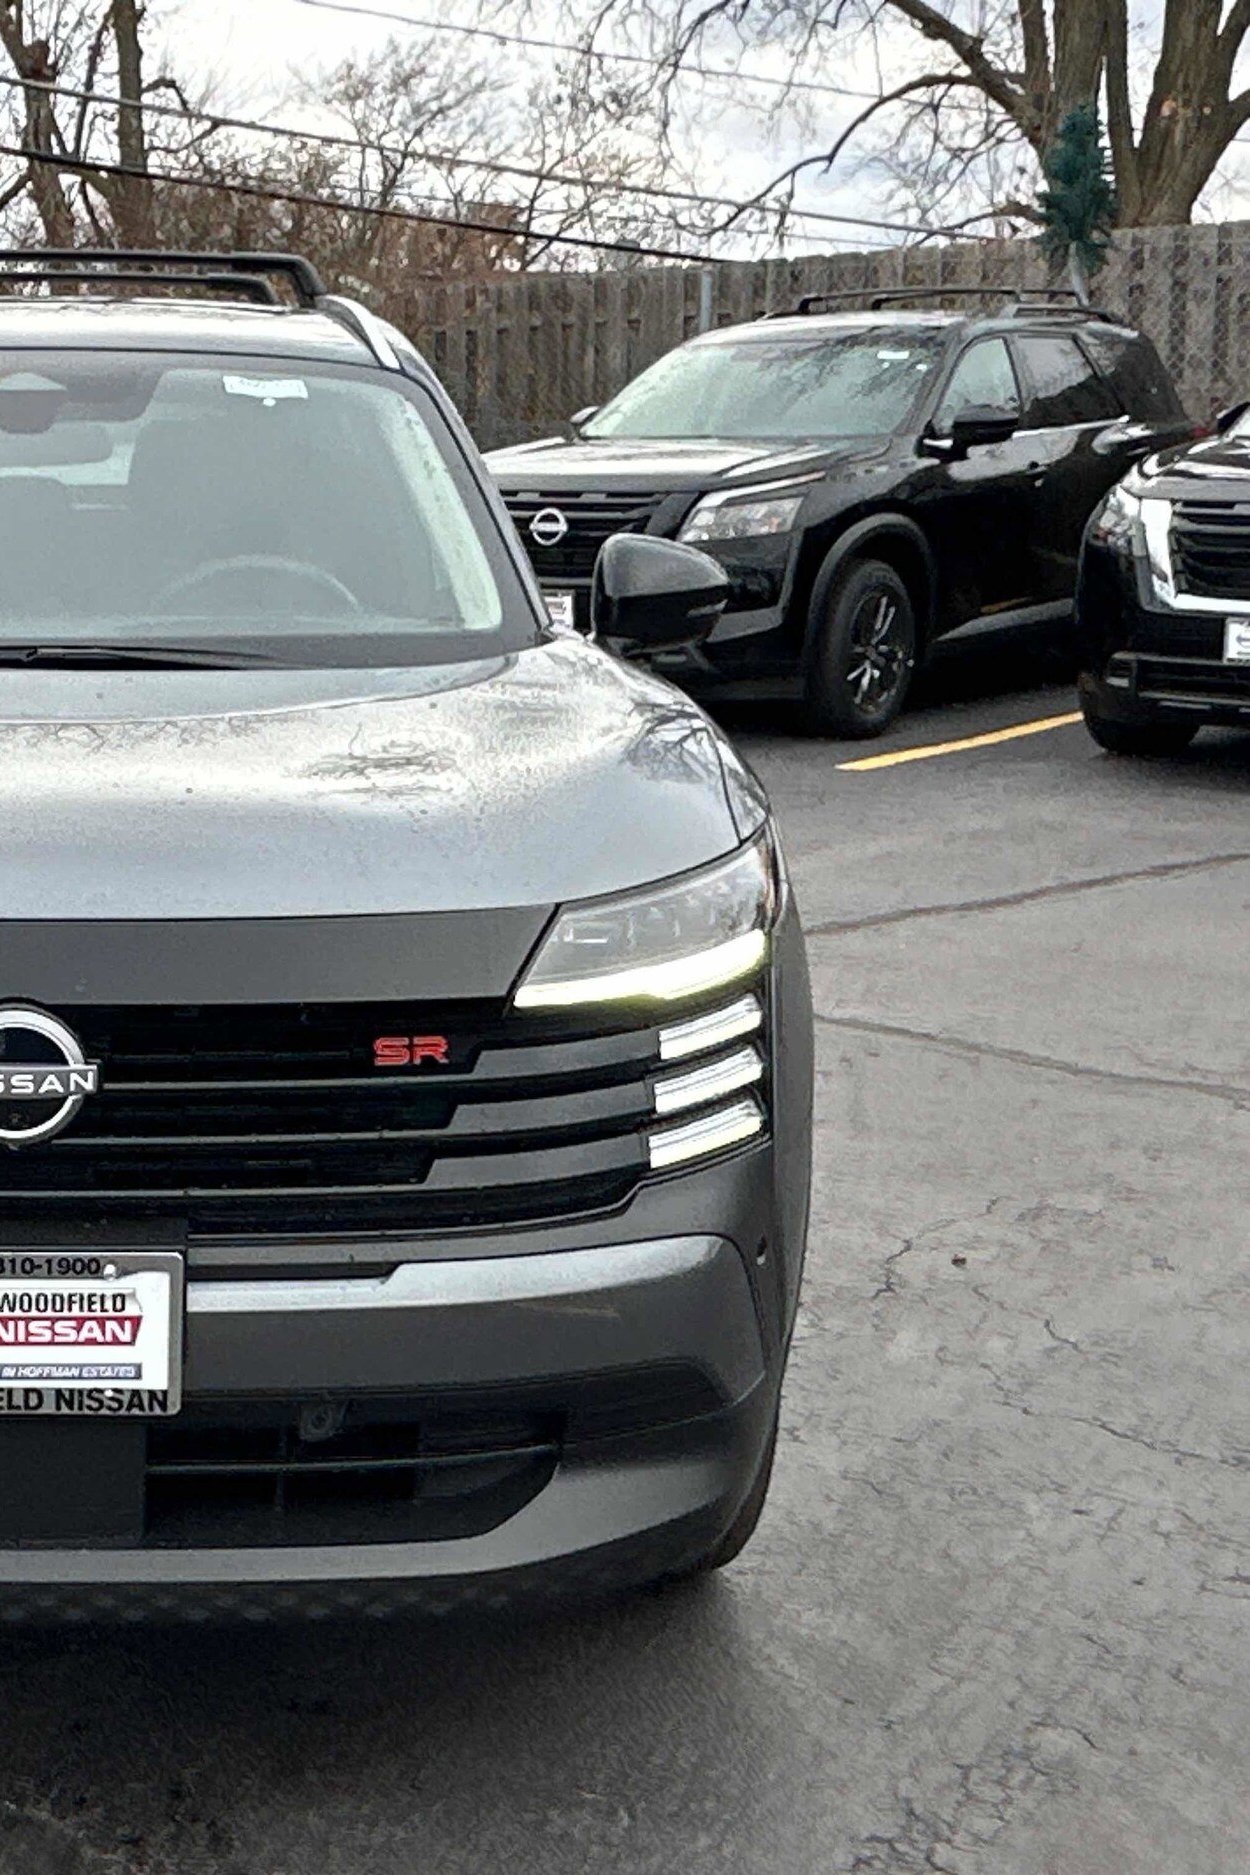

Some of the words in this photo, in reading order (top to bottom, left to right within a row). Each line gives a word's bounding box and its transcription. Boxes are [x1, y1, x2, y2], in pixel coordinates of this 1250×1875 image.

[373, 1036, 449, 1066] SR
[17, 1366, 80, 1378] HOFFMAN
[55, 1389, 168, 1413] NISSAN
